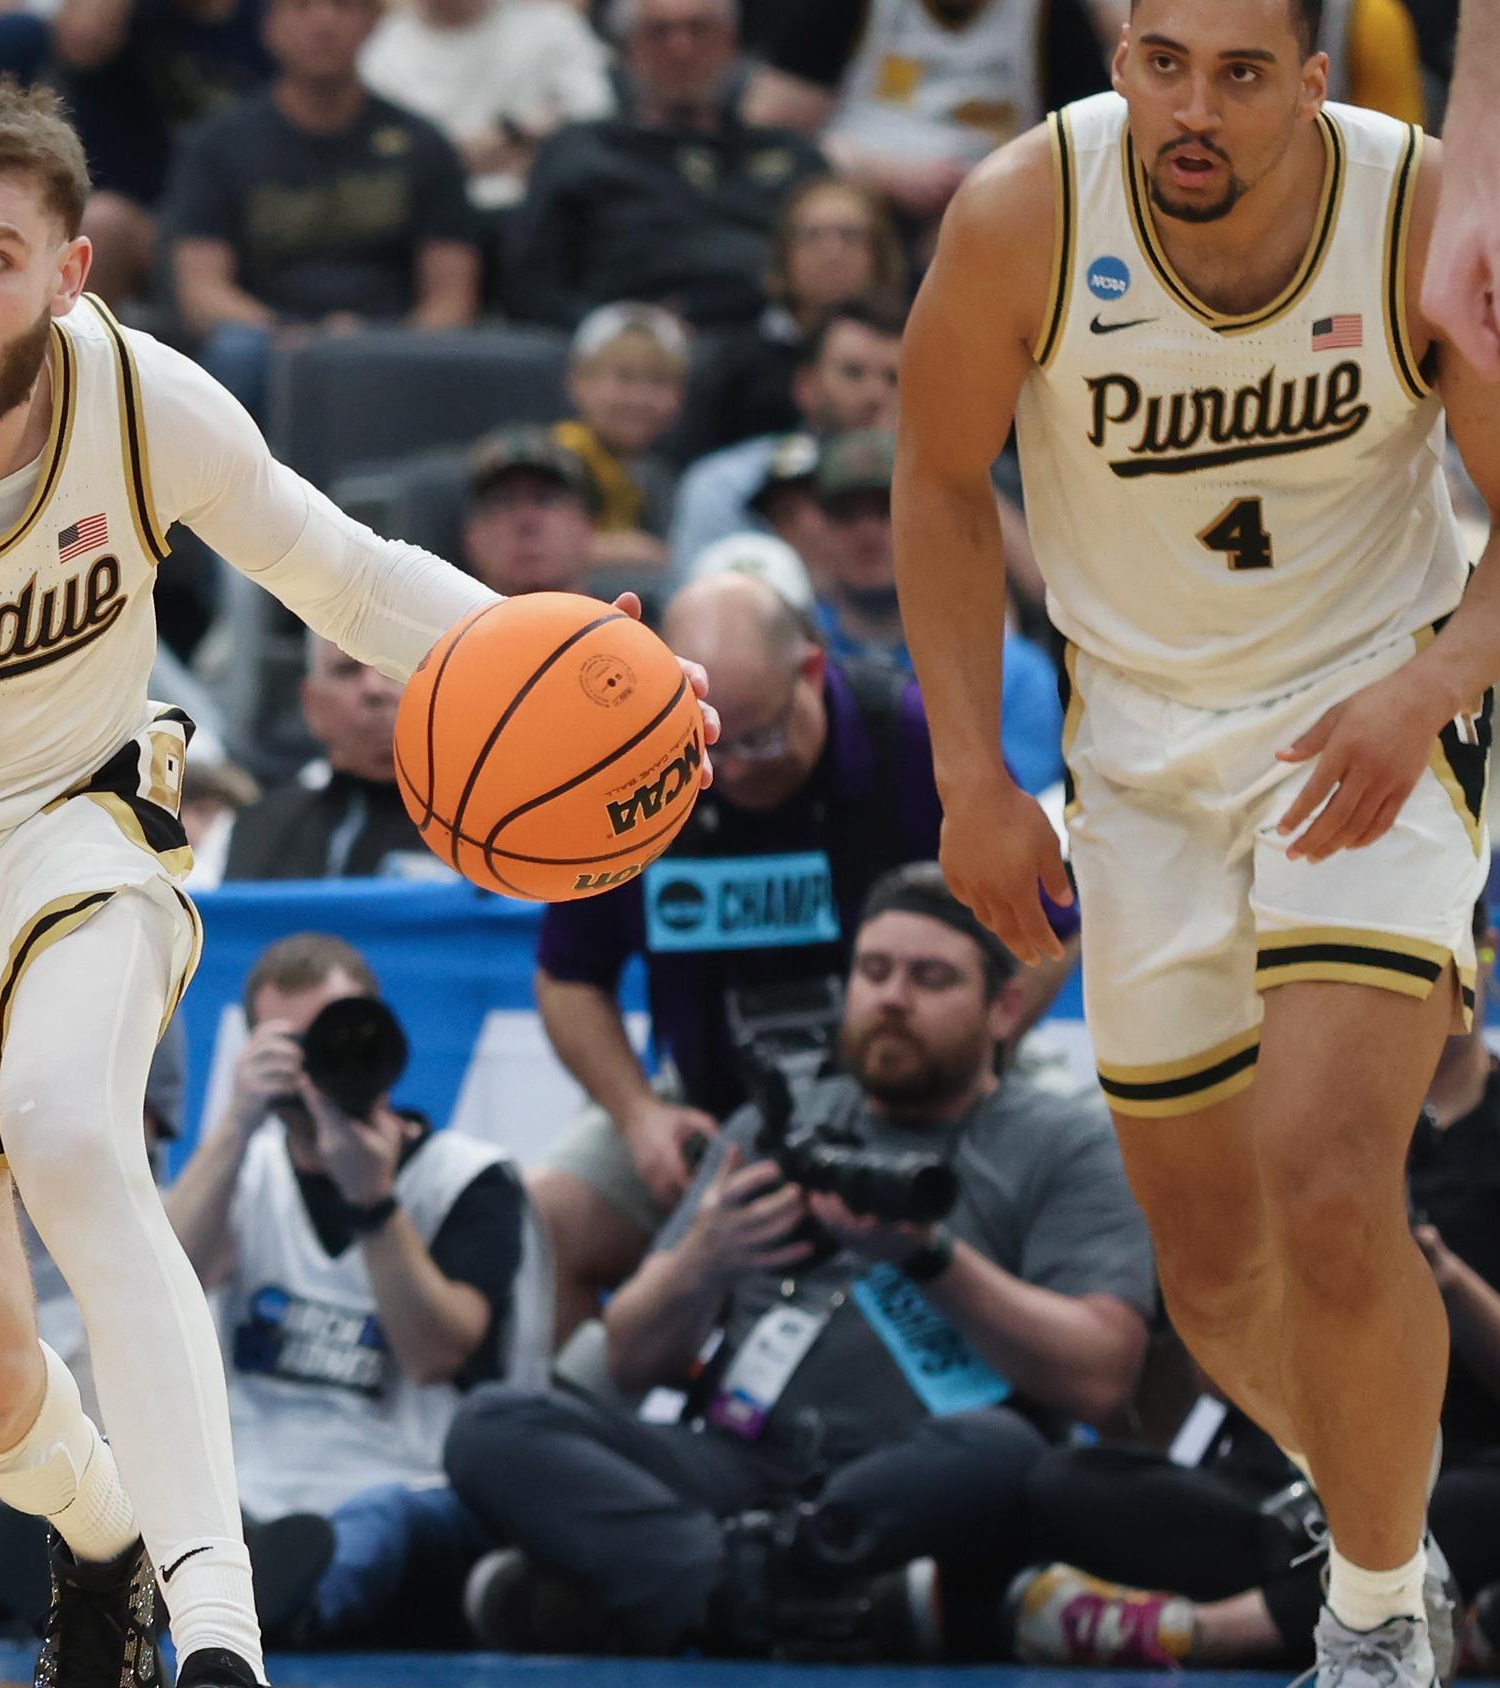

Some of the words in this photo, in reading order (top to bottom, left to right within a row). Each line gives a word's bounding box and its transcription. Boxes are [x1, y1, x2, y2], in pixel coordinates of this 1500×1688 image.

[1091, 274, 1126, 293] NCAA
[1082, 360, 1366, 456] Purdue
[1196, 496, 1273, 571] 4
[605, 727, 701, 836] NCAA
